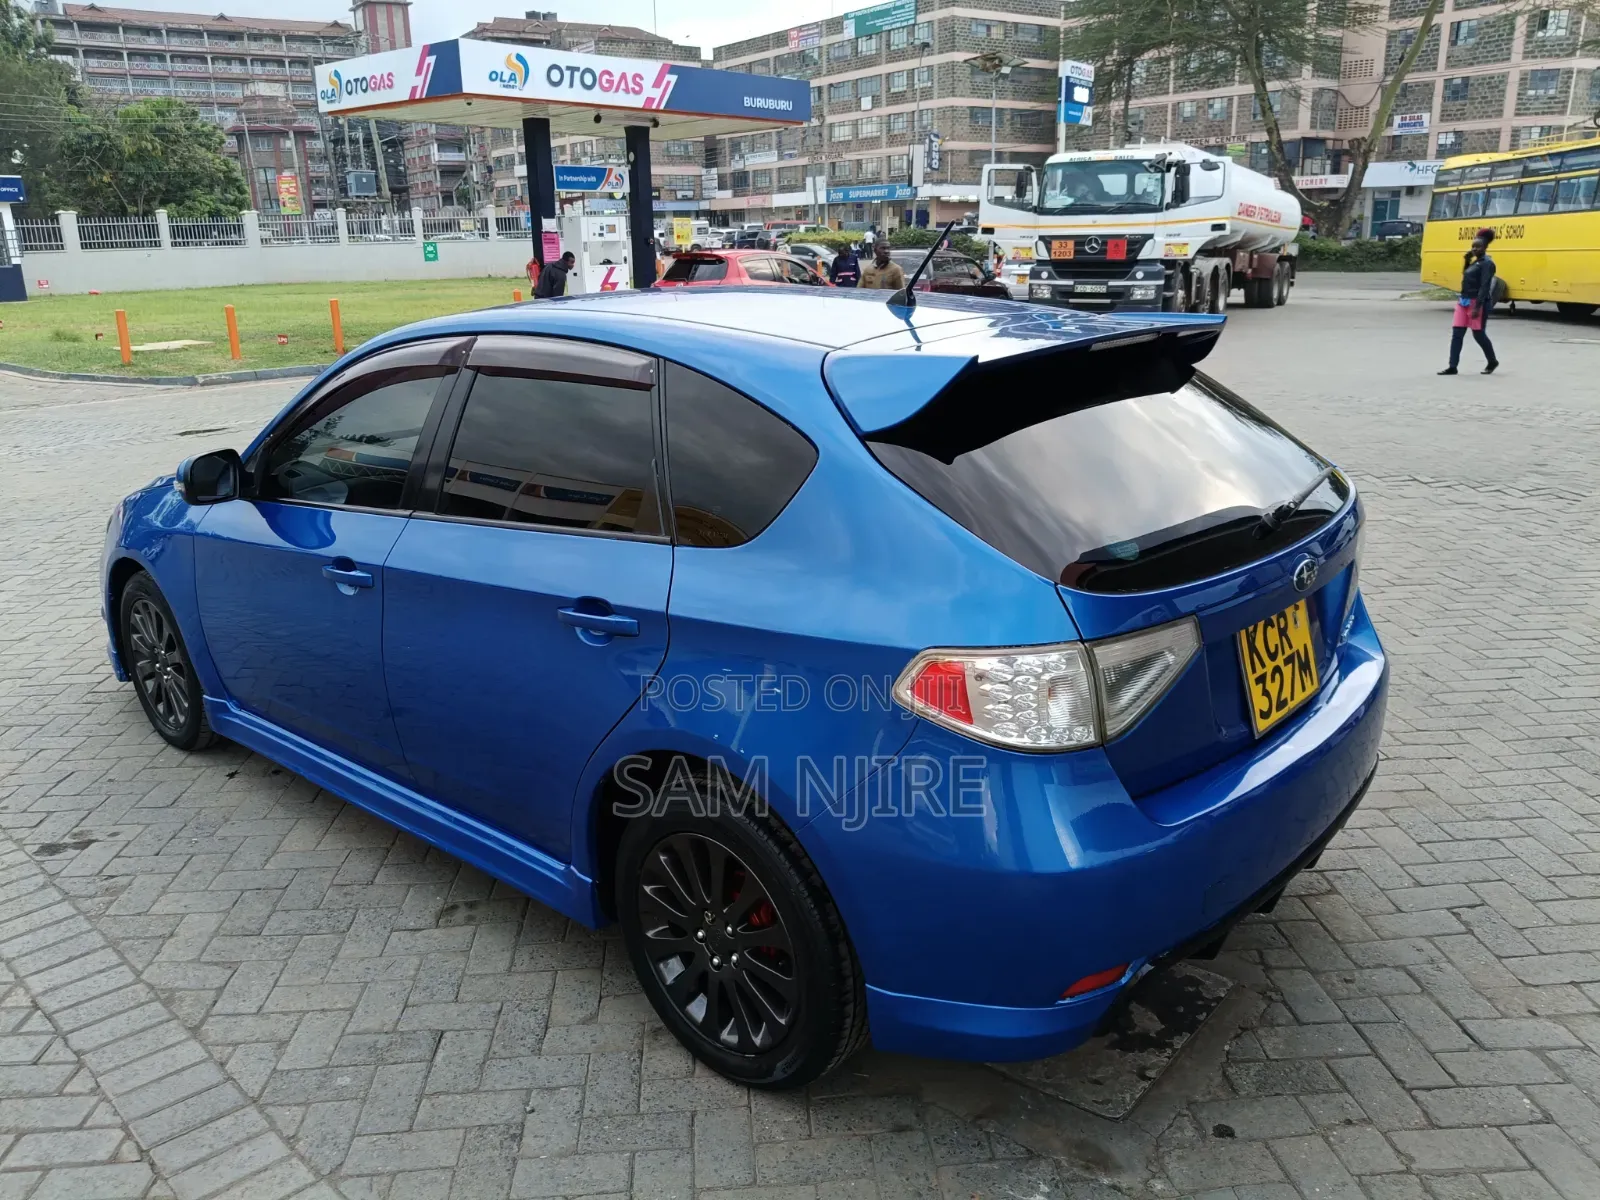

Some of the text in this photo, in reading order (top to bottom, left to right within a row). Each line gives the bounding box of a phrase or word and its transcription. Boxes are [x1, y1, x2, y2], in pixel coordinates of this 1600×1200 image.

[789, 40, 798, 48] LET
[345, 72, 394, 96] OTOGAS
[488, 70, 517, 85] OLA
[546, 64, 644, 95] OTOGAS
[320, 88, 336, 100] OLA
[743, 96, 793, 111] BURUBURU
[1215, 135, 1247, 144] CENTRE
[1417, 164, 1444, 174] HFC
[564, 174, 587, 184] Partnership
[587, 174, 597, 182] with
[1296, 178, 1328, 187] UTCHERY
[829, 186, 911, 201] jaza SUPERMARKET jaza
[1238, 202, 1257, 218] DANGER
[1057, 241, 1068, 249] 33
[1053, 250, 1072, 258] 1203
[1245, 610, 1293, 675] KCR
[1255, 643, 1315, 720] 327M
